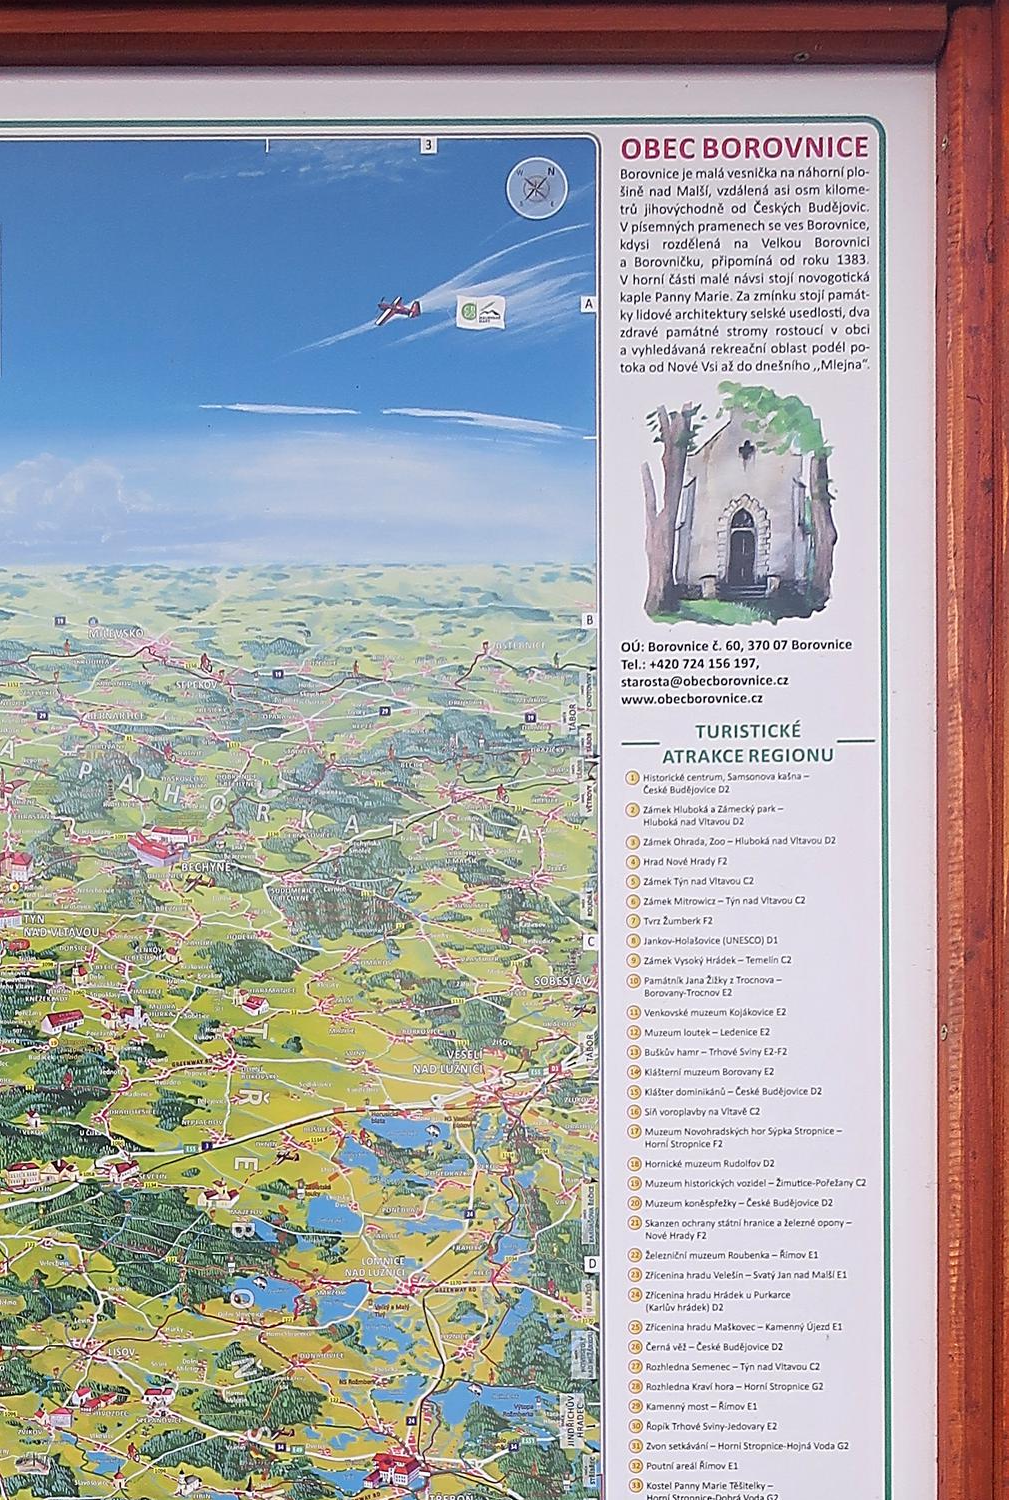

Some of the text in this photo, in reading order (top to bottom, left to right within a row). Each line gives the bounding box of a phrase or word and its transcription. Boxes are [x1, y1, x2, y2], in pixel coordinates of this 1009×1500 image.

[425, 139, 432, 150] 3
[621, 136, 868, 160] OBEC BOROVNICE
[620, 166, 869, 182] Borovnice je malá vesnička na náhorní plo-
[585, 298, 593, 309] A
[621, 638, 852, 653] OÚ: Borovnice č. 60, 370 07 Borovnice
[621, 658, 759, 670] Tel.: +420 724 156 197,
[621, 674, 789, 688] starosta@obecborovnice.cz
[621, 692, 763, 705] www.obecborovnice.cz
[695, 720, 801, 739] TURISTICKÉ
[662, 748, 833, 764] ATRAKCE REGIONU
[643, 857, 727, 867] Hrad Nové Hrady F2
[643, 915, 713, 925] Tvrz Žumberk F2
[644, 1008, 689, 1017] Venkovské
[729, 1008, 774, 1018] Kojákovice
[776, 1008, 787, 1016] E2
[413, 1064, 437, 1074] NAD
[565, 1395, 575, 1447] JINDŘICHŮV
